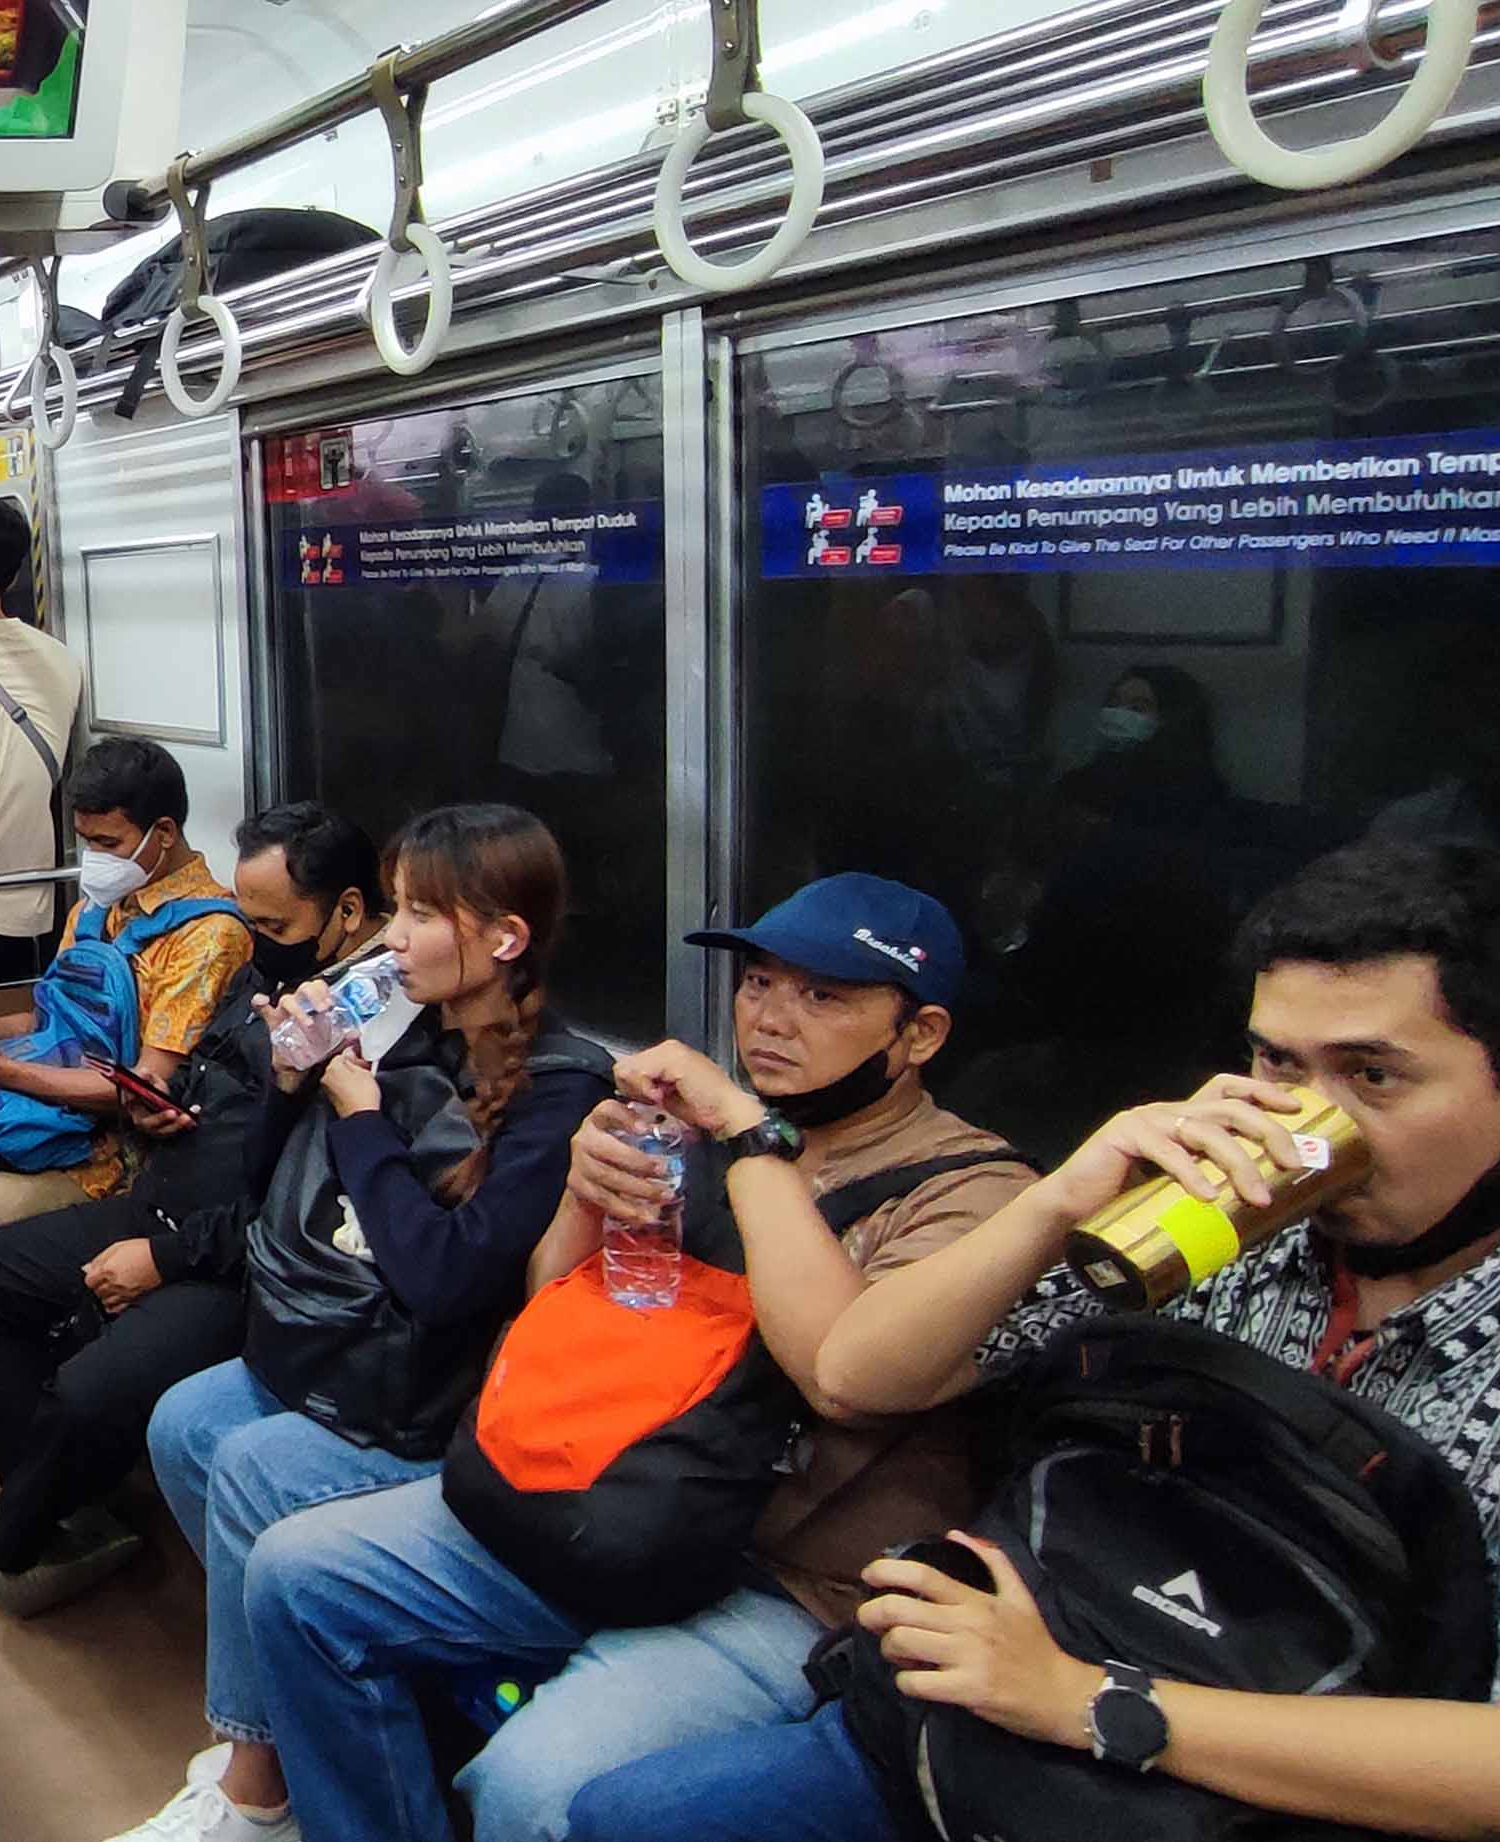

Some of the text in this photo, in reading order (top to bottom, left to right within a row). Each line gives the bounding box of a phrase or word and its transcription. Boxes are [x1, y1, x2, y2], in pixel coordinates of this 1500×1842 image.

[944, 484, 1011, 503] Mohon
[1015, 475, 1172, 499] Kesadarannya
[1177, 465, 1246, 489] Untuk
[1251, 457, 1420, 485] Memberikan
[597, 512, 637, 528] Duduk
[943, 511, 1022, 533] Kepada
[1027, 507, 1159, 528] Penumpang
[1164, 501, 1223, 525] Yang
[1230, 496, 1299, 519] Lebih
[1095, 539, 1121, 552] The
[1124, 537, 1158, 551] Seat
[1161, 536, 1187, 550] For
[1189, 535, 1235, 549] Other
[1238, 533, 1335, 550] Passengers
[1339, 531, 1381, 546] Who
[1384, 529, 1439, 544] Need
